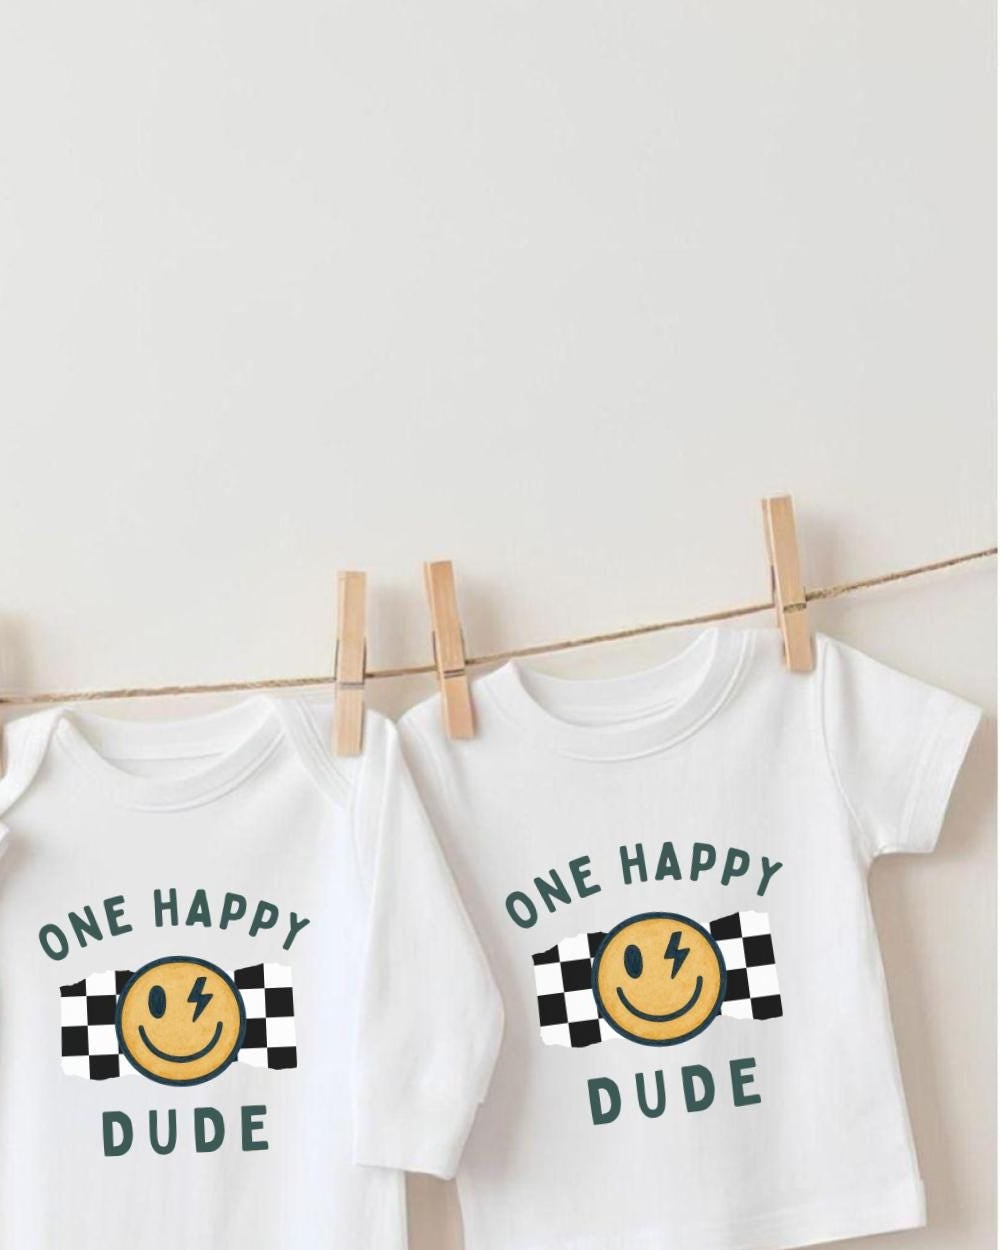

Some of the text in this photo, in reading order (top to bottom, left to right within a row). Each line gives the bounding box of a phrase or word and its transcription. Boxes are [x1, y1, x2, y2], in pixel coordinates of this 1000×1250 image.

[505, 841, 784, 929] ONE HAPPY
[39, 887, 311, 961] ONE HAPPY
[587, 1057, 762, 1126] DUDE
[102, 1104, 270, 1158] DUDE
